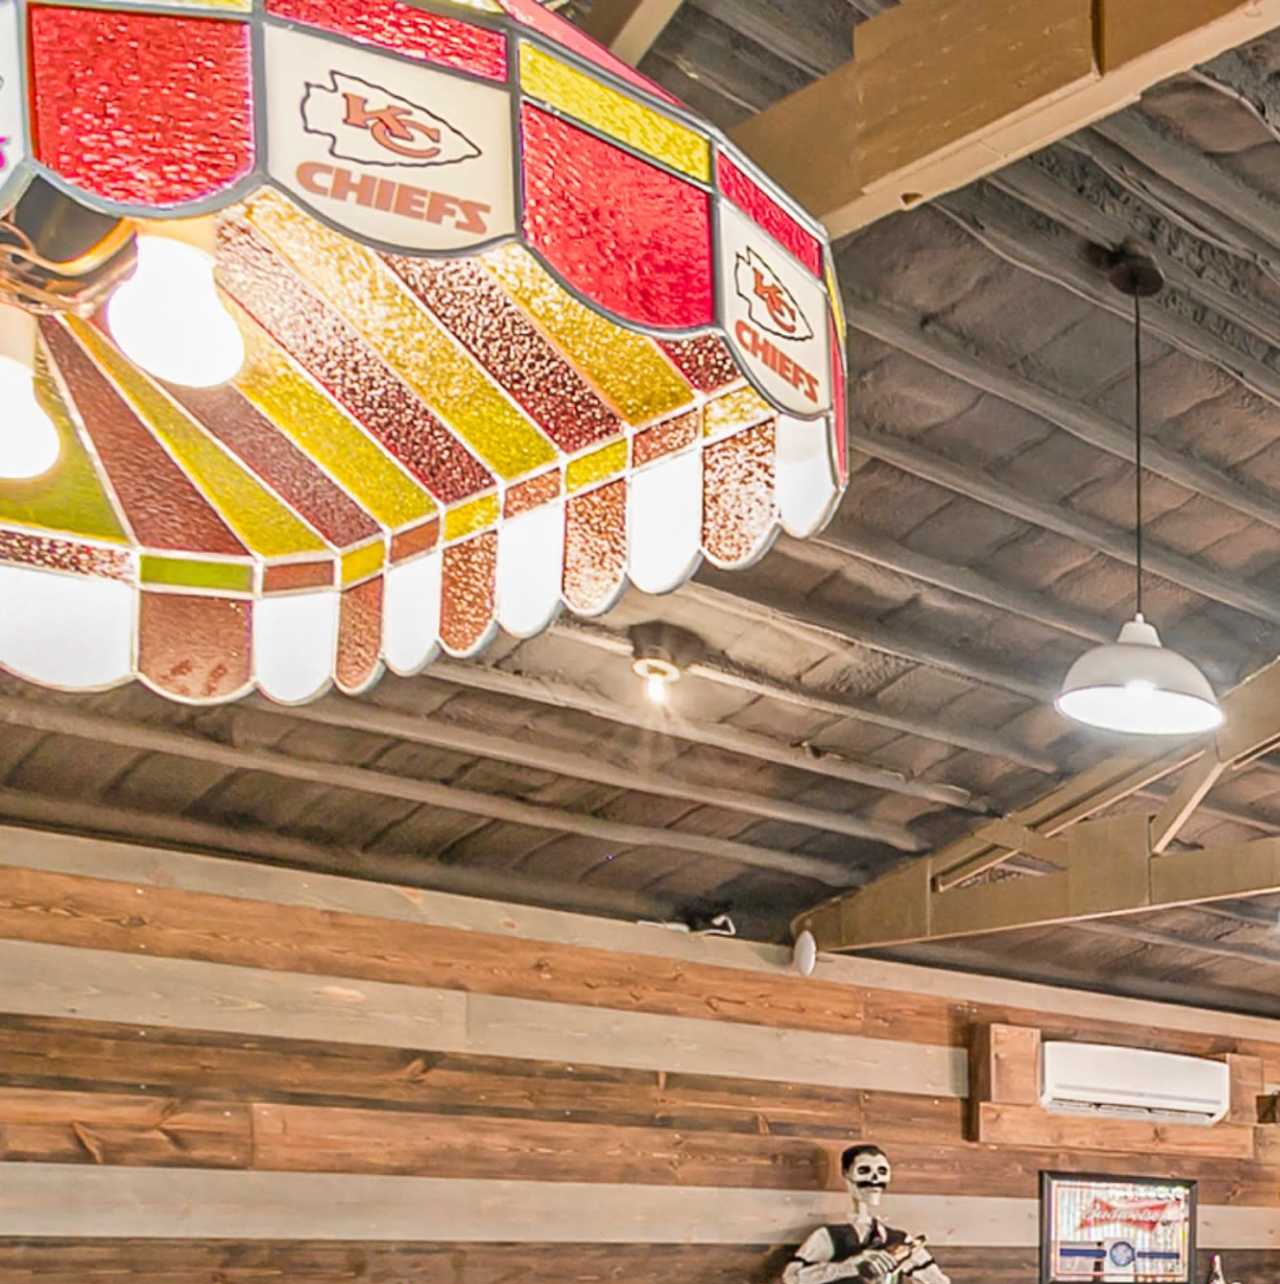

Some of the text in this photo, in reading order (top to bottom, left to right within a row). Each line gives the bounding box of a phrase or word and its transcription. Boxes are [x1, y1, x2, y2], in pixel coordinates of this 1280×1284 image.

[342, 93, 441, 159] KC
[296, 161, 492, 235] CHIEFS
[752, 267, 796, 333] KC
[735, 320, 819, 404] CHIEFS
